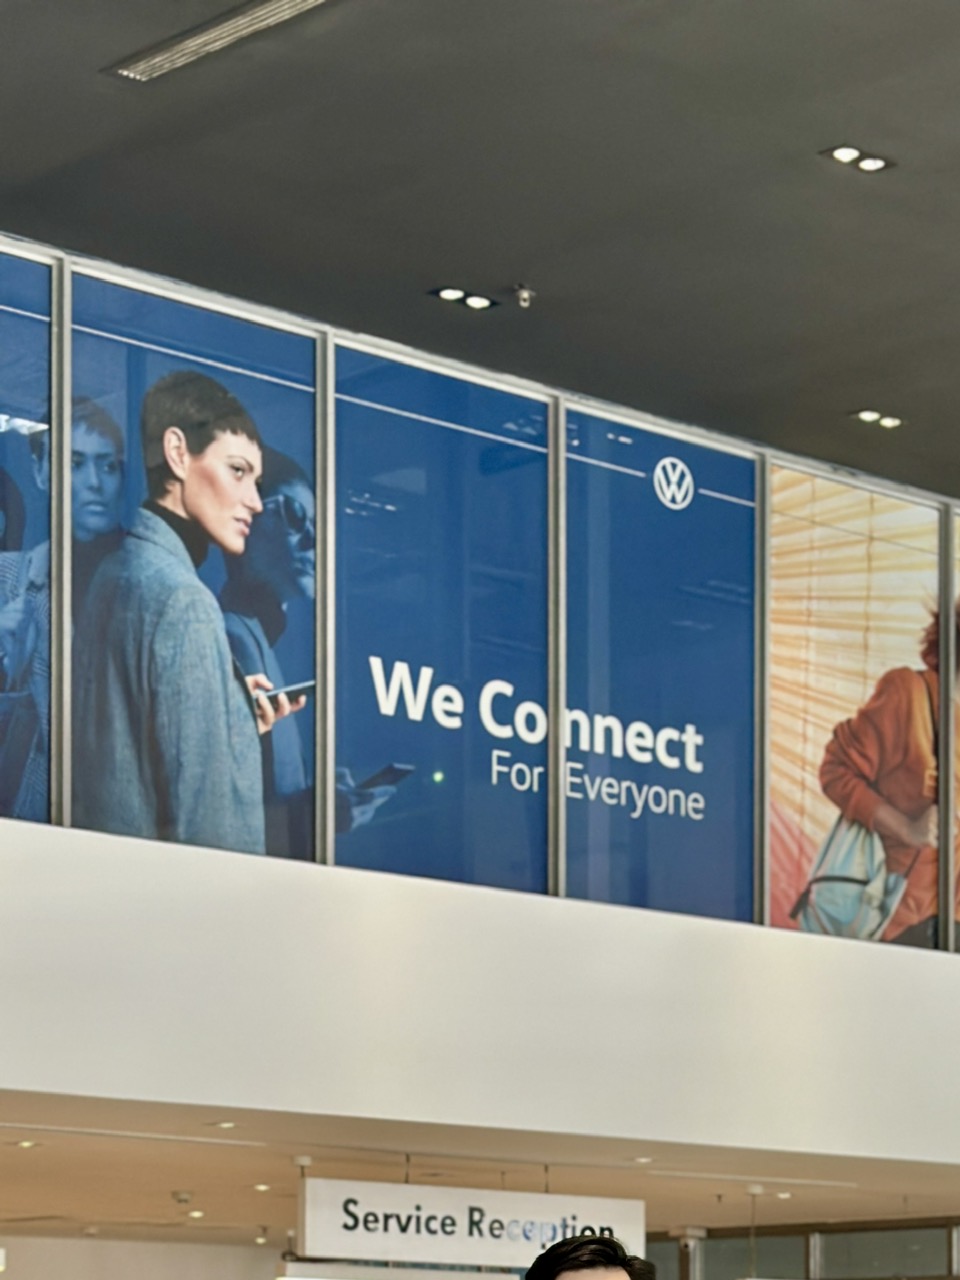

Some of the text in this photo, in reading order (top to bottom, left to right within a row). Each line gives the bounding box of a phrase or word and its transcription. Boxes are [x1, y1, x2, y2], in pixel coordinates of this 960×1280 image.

[368, 655, 704, 774] We Connect
[491, 749, 705, 820] For Everyone
[342, 1198, 457, 1235] Service
